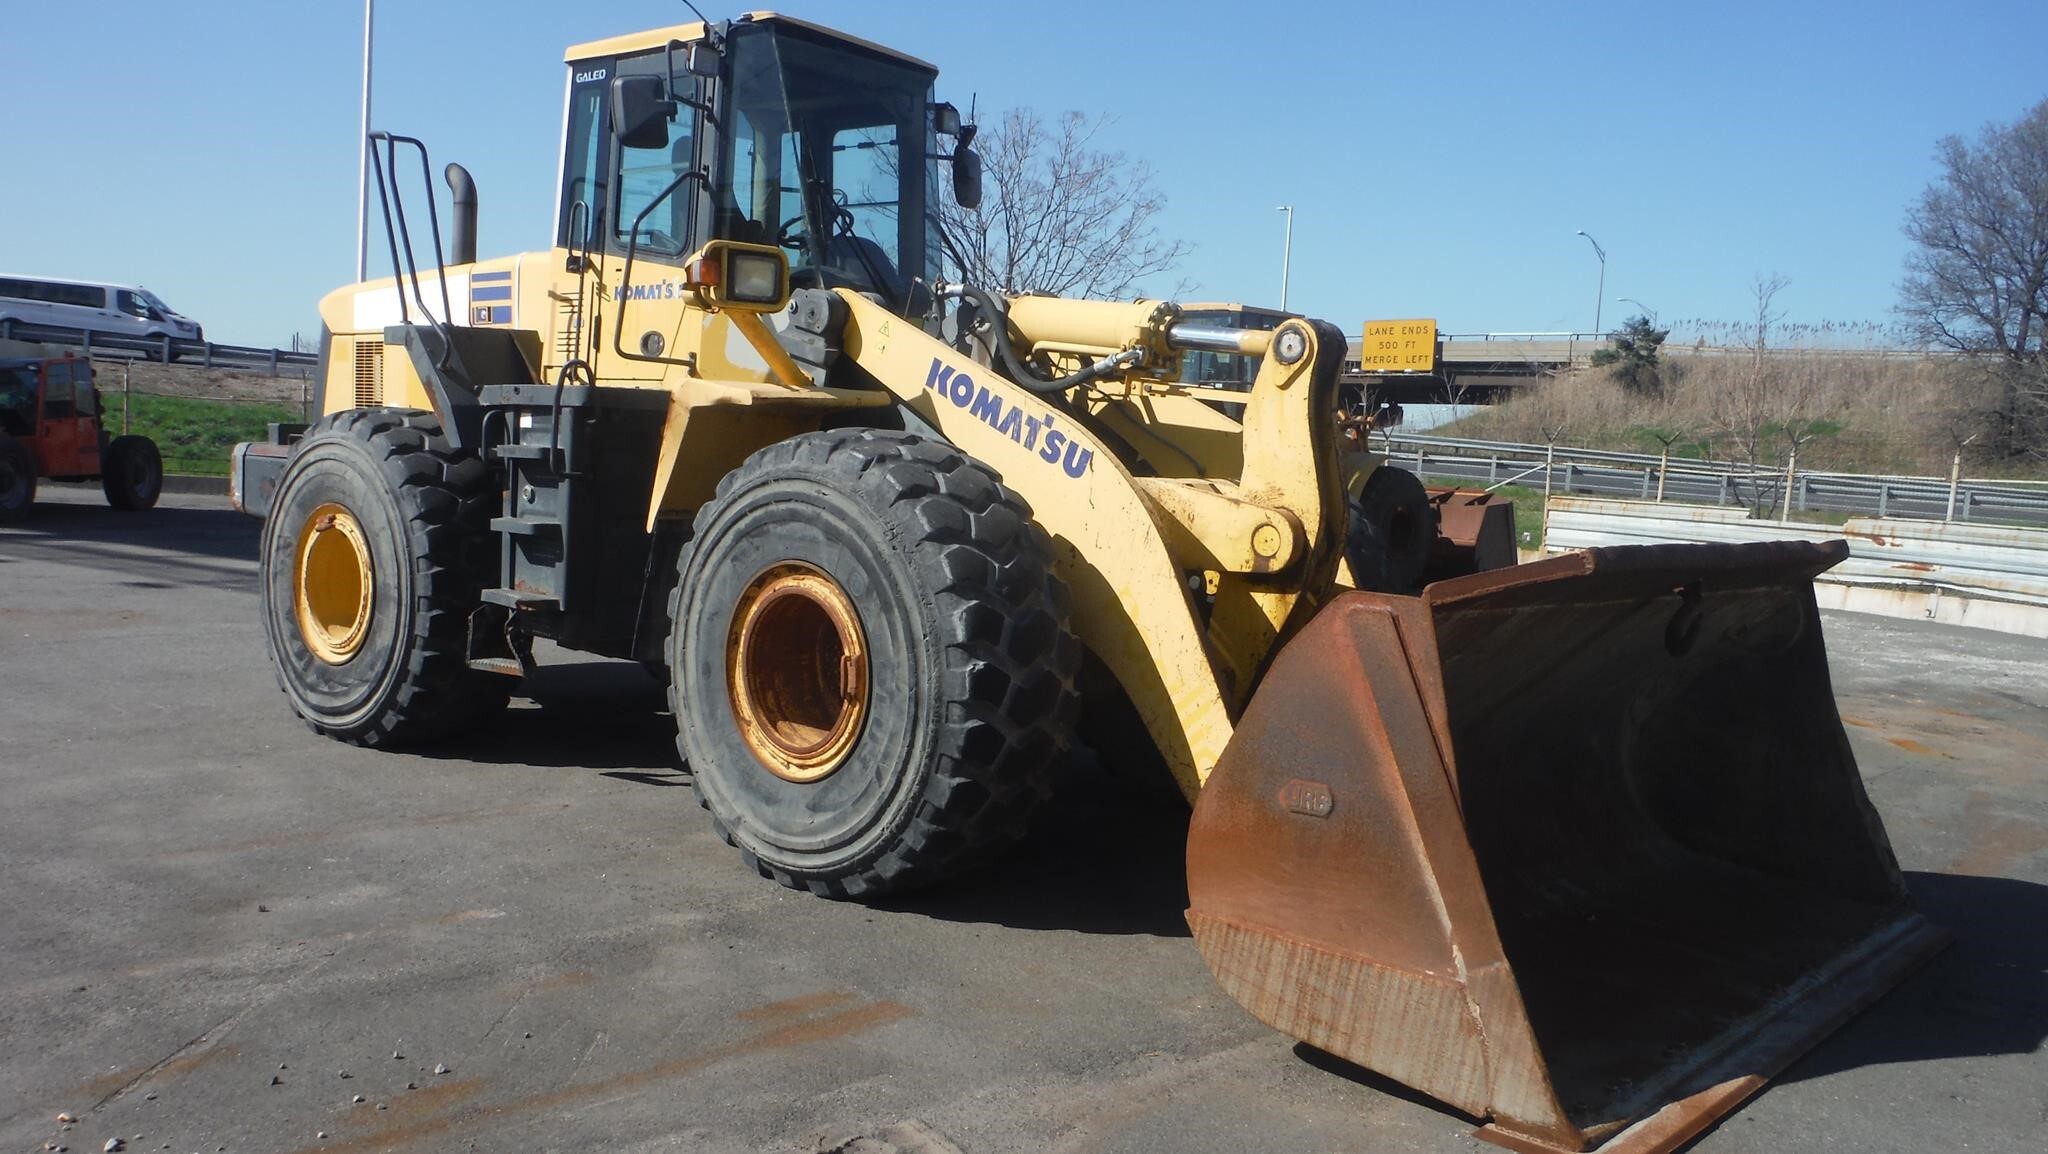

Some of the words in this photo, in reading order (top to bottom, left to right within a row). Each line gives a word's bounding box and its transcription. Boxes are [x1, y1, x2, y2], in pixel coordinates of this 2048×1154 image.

[576, 69, 606, 83] GALEO
[614, 279, 684, 300] KOMATS
[1369, 327, 1395, 336] LANE
[1401, 326, 1429, 335] ENDS
[1379, 341, 1398, 350] 500
[1405, 341, 1416, 349] FT
[1365, 355, 1398, 364] MERGE
[1405, 355, 1429, 364] LEFT
[925, 357, 1091, 479] KOMATSU
